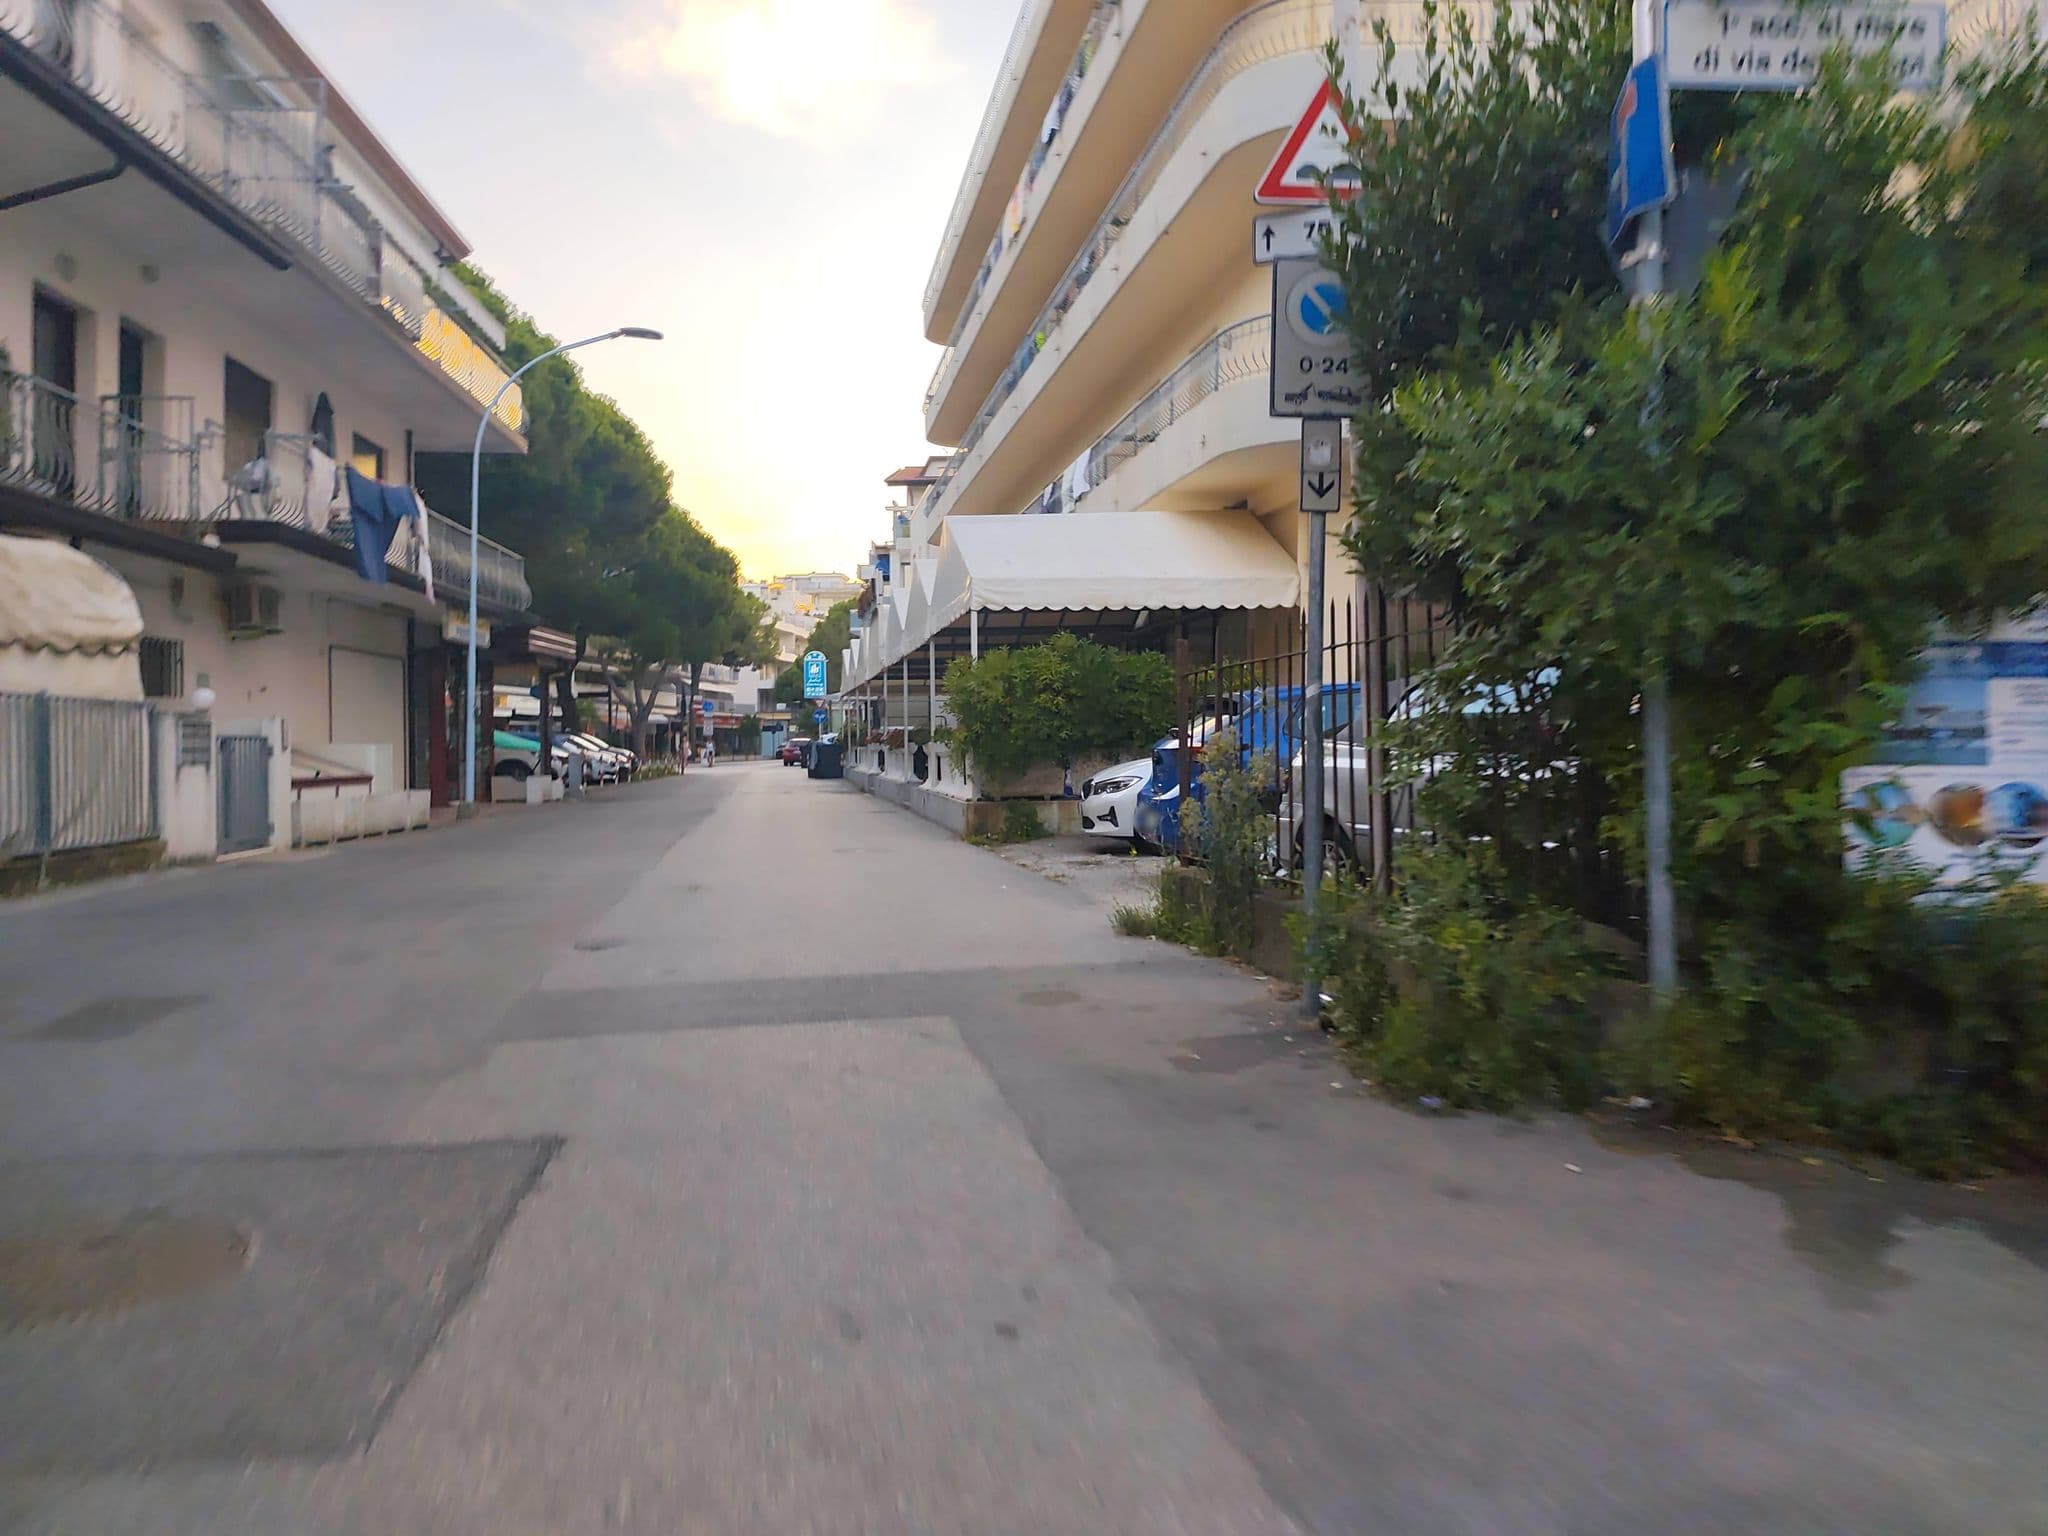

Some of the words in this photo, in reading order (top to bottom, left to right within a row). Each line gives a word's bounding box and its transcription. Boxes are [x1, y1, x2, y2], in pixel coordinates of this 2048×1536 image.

[1817, 10, 1842, 36] al
[1855, 15, 1926, 37] mare
[1693, 45, 1720, 71] di
[1731, 45, 1771, 72] via
[1299, 355, 1349, 375] 0-24
